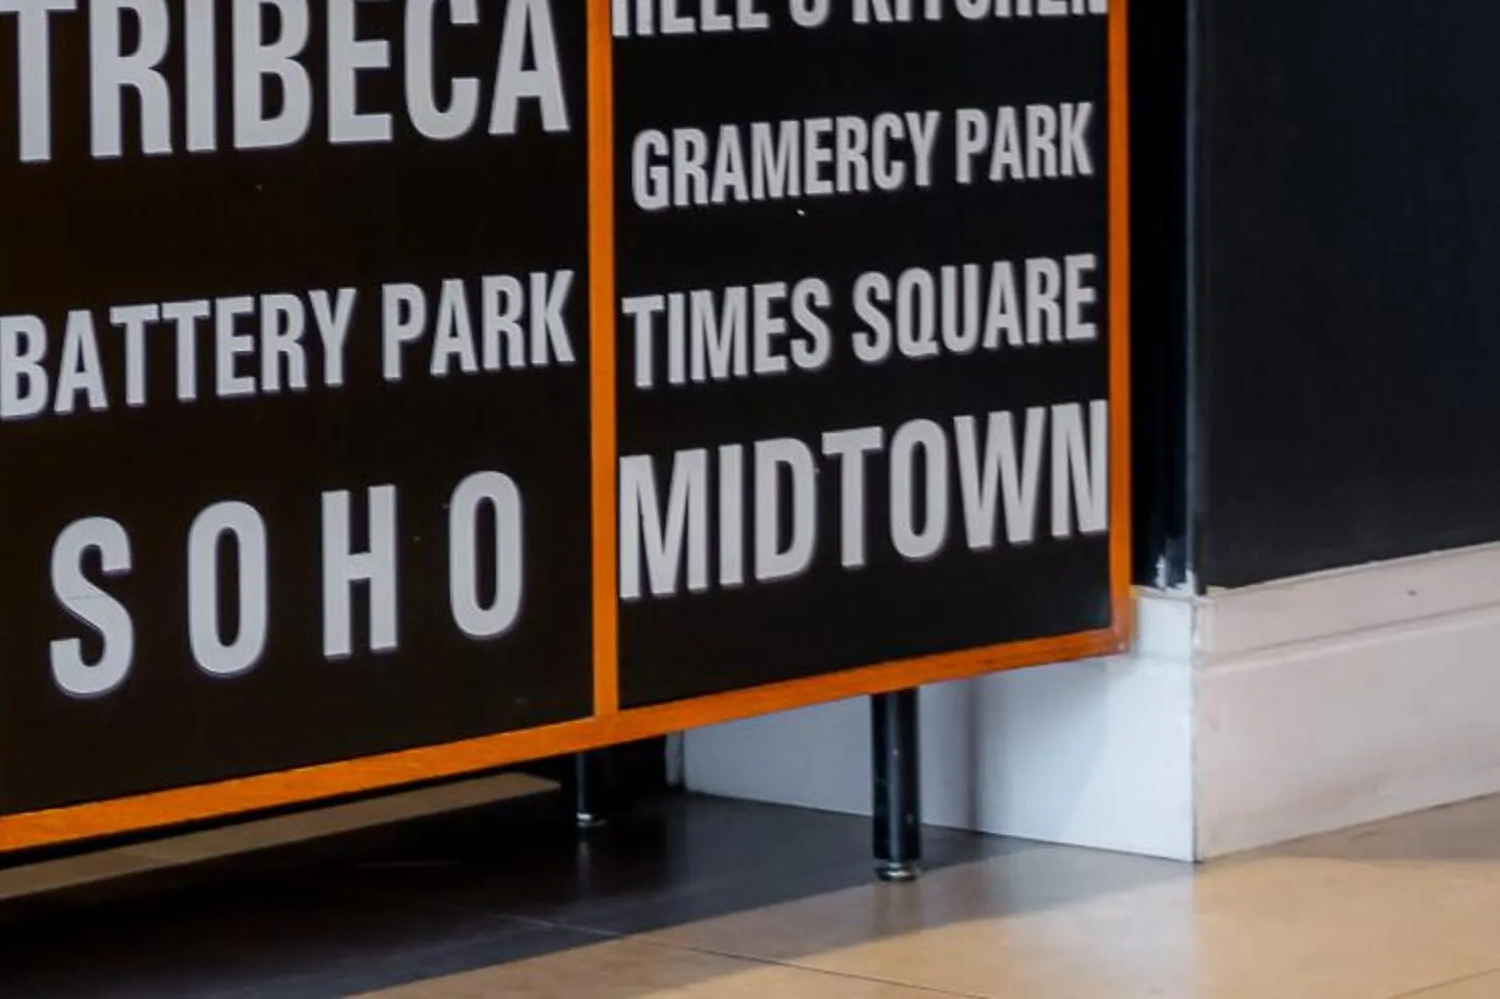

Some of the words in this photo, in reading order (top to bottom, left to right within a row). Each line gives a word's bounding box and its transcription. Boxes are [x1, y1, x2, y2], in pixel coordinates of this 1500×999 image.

[630, 109, 941, 212] GRAMERCY
[954, 100, 1095, 185] PARK
[380, 268, 577, 382] PARK
[620, 276, 833, 390] TIMES
[850, 252, 1099, 364] SQUARE
[618, 398, 1109, 601] MIDTOWN
[47, 469, 524, 697] SOHO
